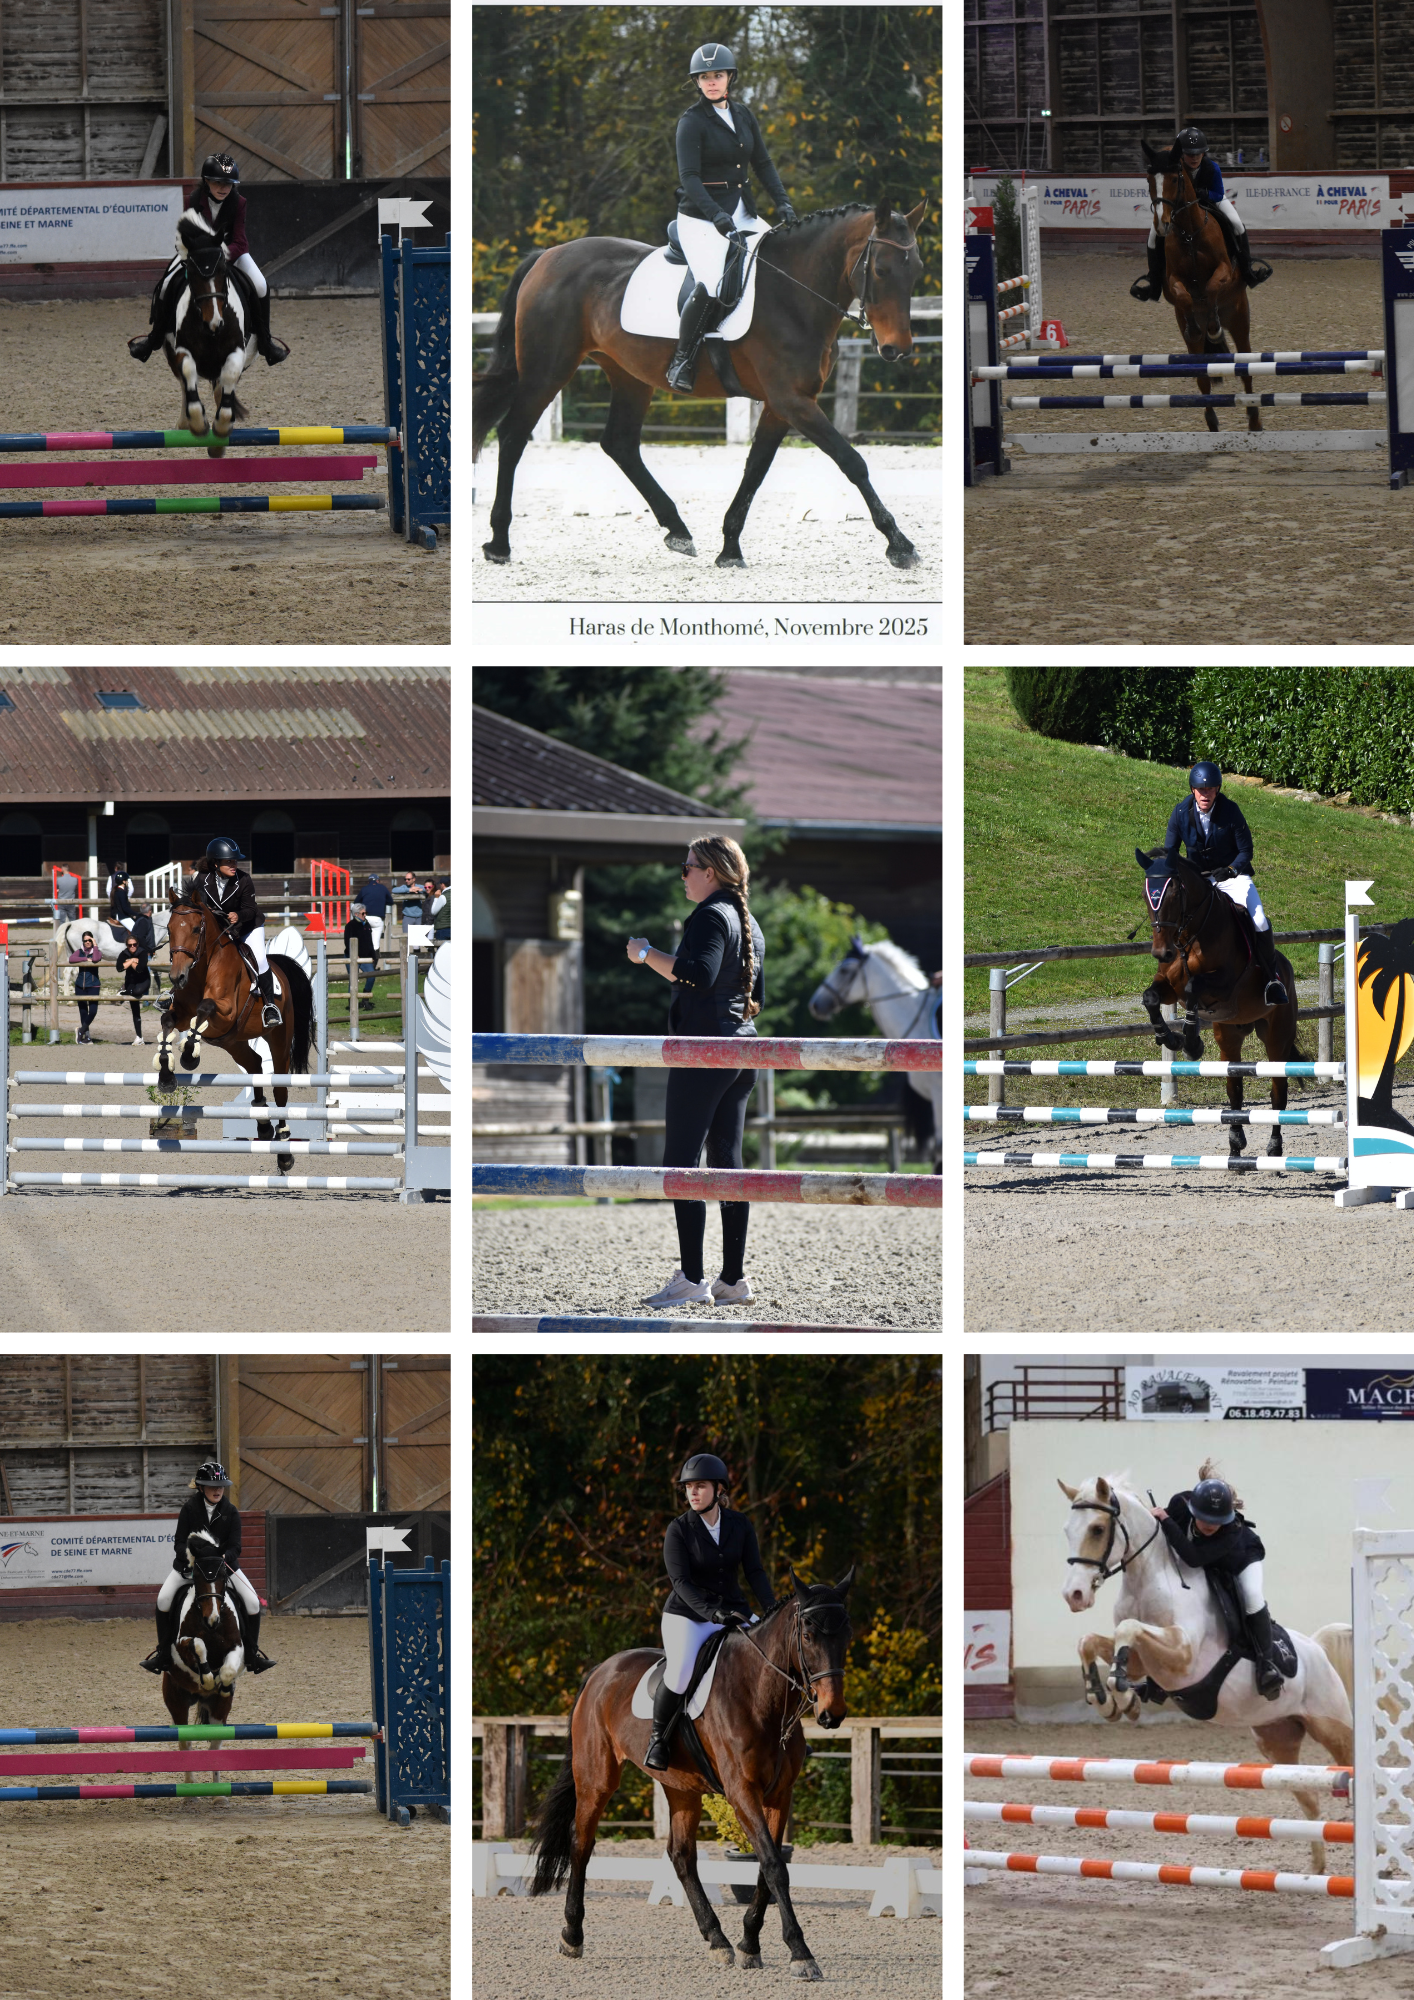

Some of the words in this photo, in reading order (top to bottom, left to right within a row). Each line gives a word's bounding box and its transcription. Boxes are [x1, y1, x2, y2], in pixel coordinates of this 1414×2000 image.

[1044, 186, 1051, 198] À
[1053, 188, 1088, 198] CHEVAL
[1246, 187, 1310, 197] ILE-DE-FRANCE
[1316, 184, 1325, 197] À
[1327, 186, 1367, 197] CHEVAL
[20, 205, 100, 217] DÉPARTEMENTAL
[1062, 200, 1101, 217] PARIS
[1338, 199, 1381, 218] PARIS
[0, 220, 21, 230] EINE
[25, 220, 35, 229] ET
[38, 219, 73, 229] MARNE
[1046, 324, 1057, 341] 6
[1228, 1369, 1271, 1377] Ravalement
[1221, 1377, 1262, 1385] Rénovation
[1229, 1409, 1300, 1418] 06.18.49.47.83
[51, 1535, 84, 1546] COMITÉ
[86, 1534, 156, 1545] DÉPARTEMENTAL
[51, 1549, 62, 1557] DE
[64, 1548, 87, 1556] SEINE
[90, 1548, 99, 1556] ET
[101, 1547, 133, 1555] MARNE
